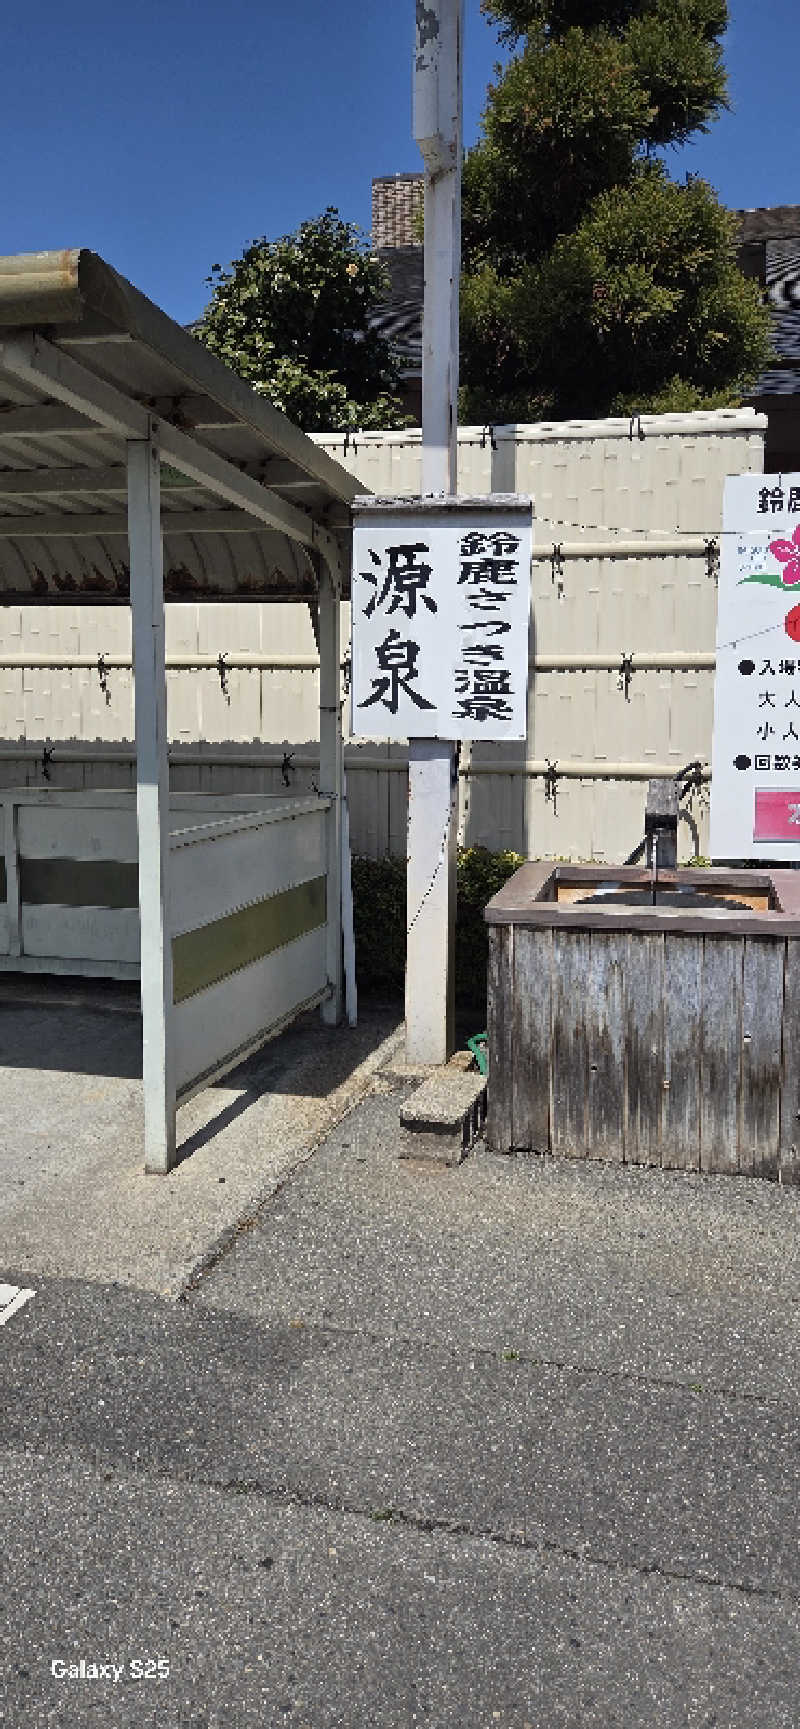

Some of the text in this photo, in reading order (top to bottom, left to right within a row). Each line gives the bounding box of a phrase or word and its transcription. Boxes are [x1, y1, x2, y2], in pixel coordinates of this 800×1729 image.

[357, 543, 438, 714] 源泉
[452, 532, 523, 722] 鈴鹿さつき温泉
[759, 659, 800, 676] 入場
